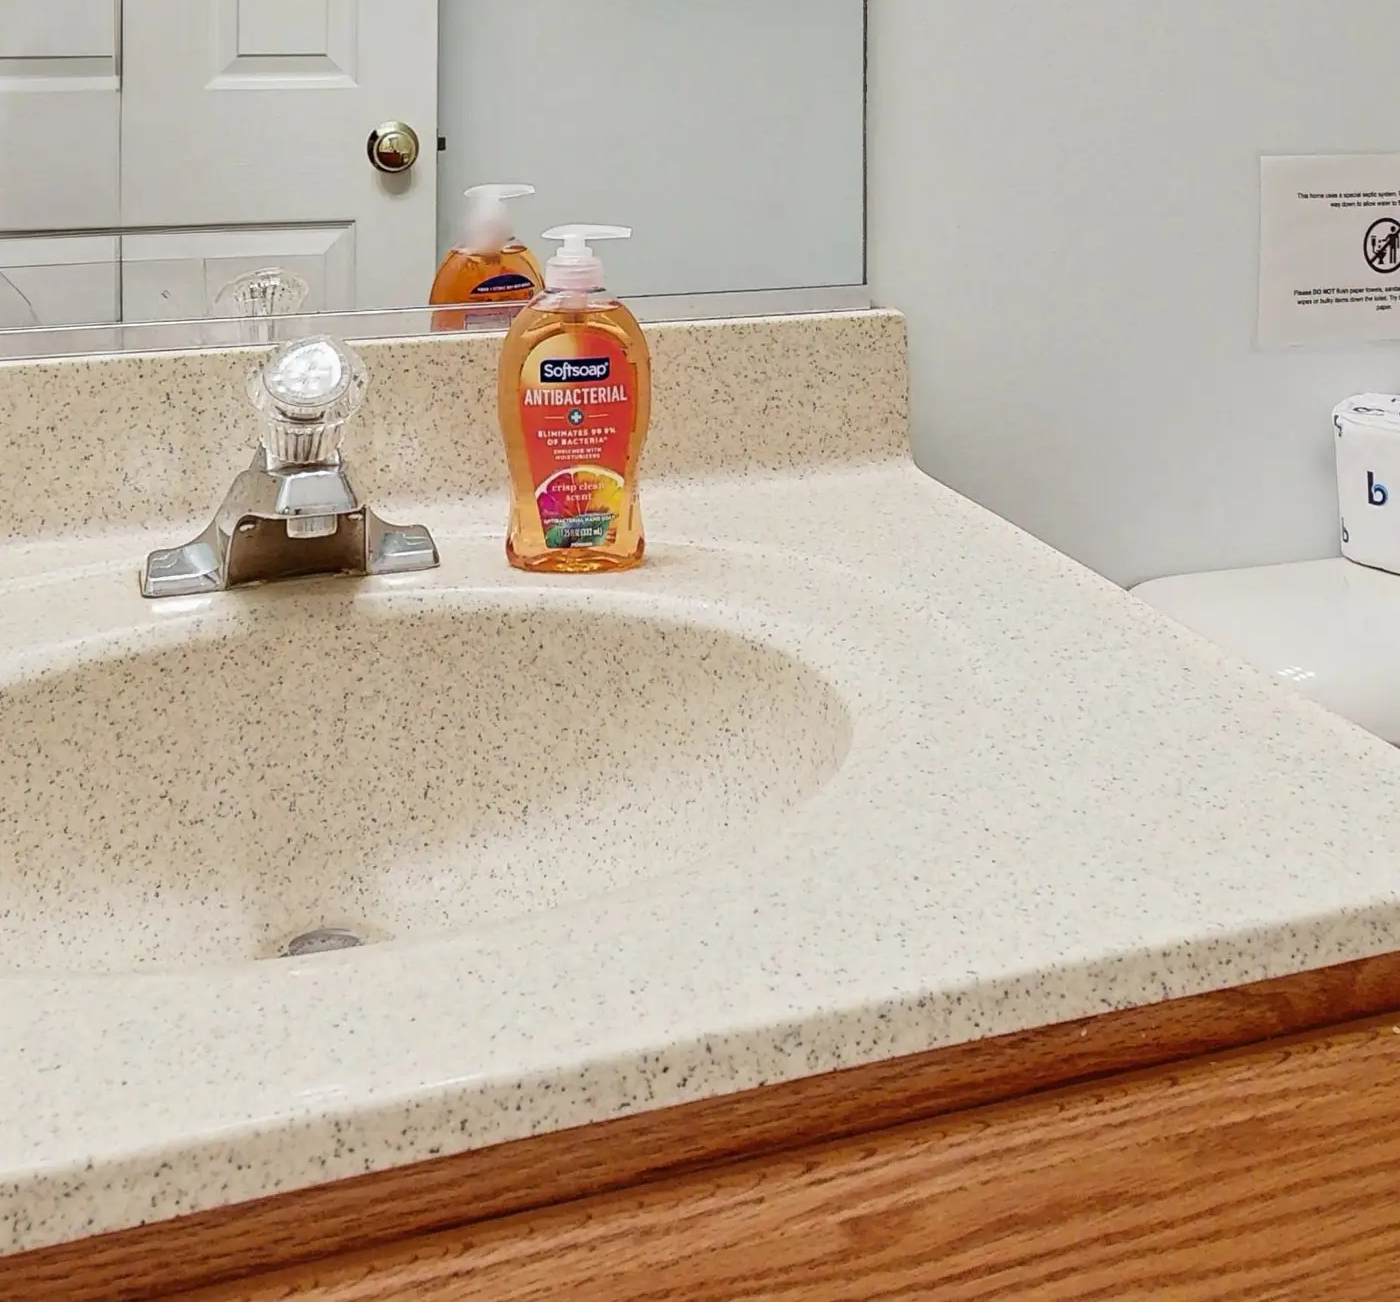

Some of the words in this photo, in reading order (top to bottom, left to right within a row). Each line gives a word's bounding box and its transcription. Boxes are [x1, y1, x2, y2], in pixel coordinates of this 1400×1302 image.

[1343, 191, 1361, 200] special
[543, 361, 607, 381] Softsoap
[524, 384, 628, 406] ANTIBACTERIAL
[537, 428, 589, 438] ELIMINATES
[546, 438, 558, 446] OF
[555, 453, 600, 461] MOISTURIZERS
[551, 483, 577, 492] crisp
[578, 481, 605, 491] clean
[1366, 471, 1388, 506] b
[565, 493, 592, 501] scent
